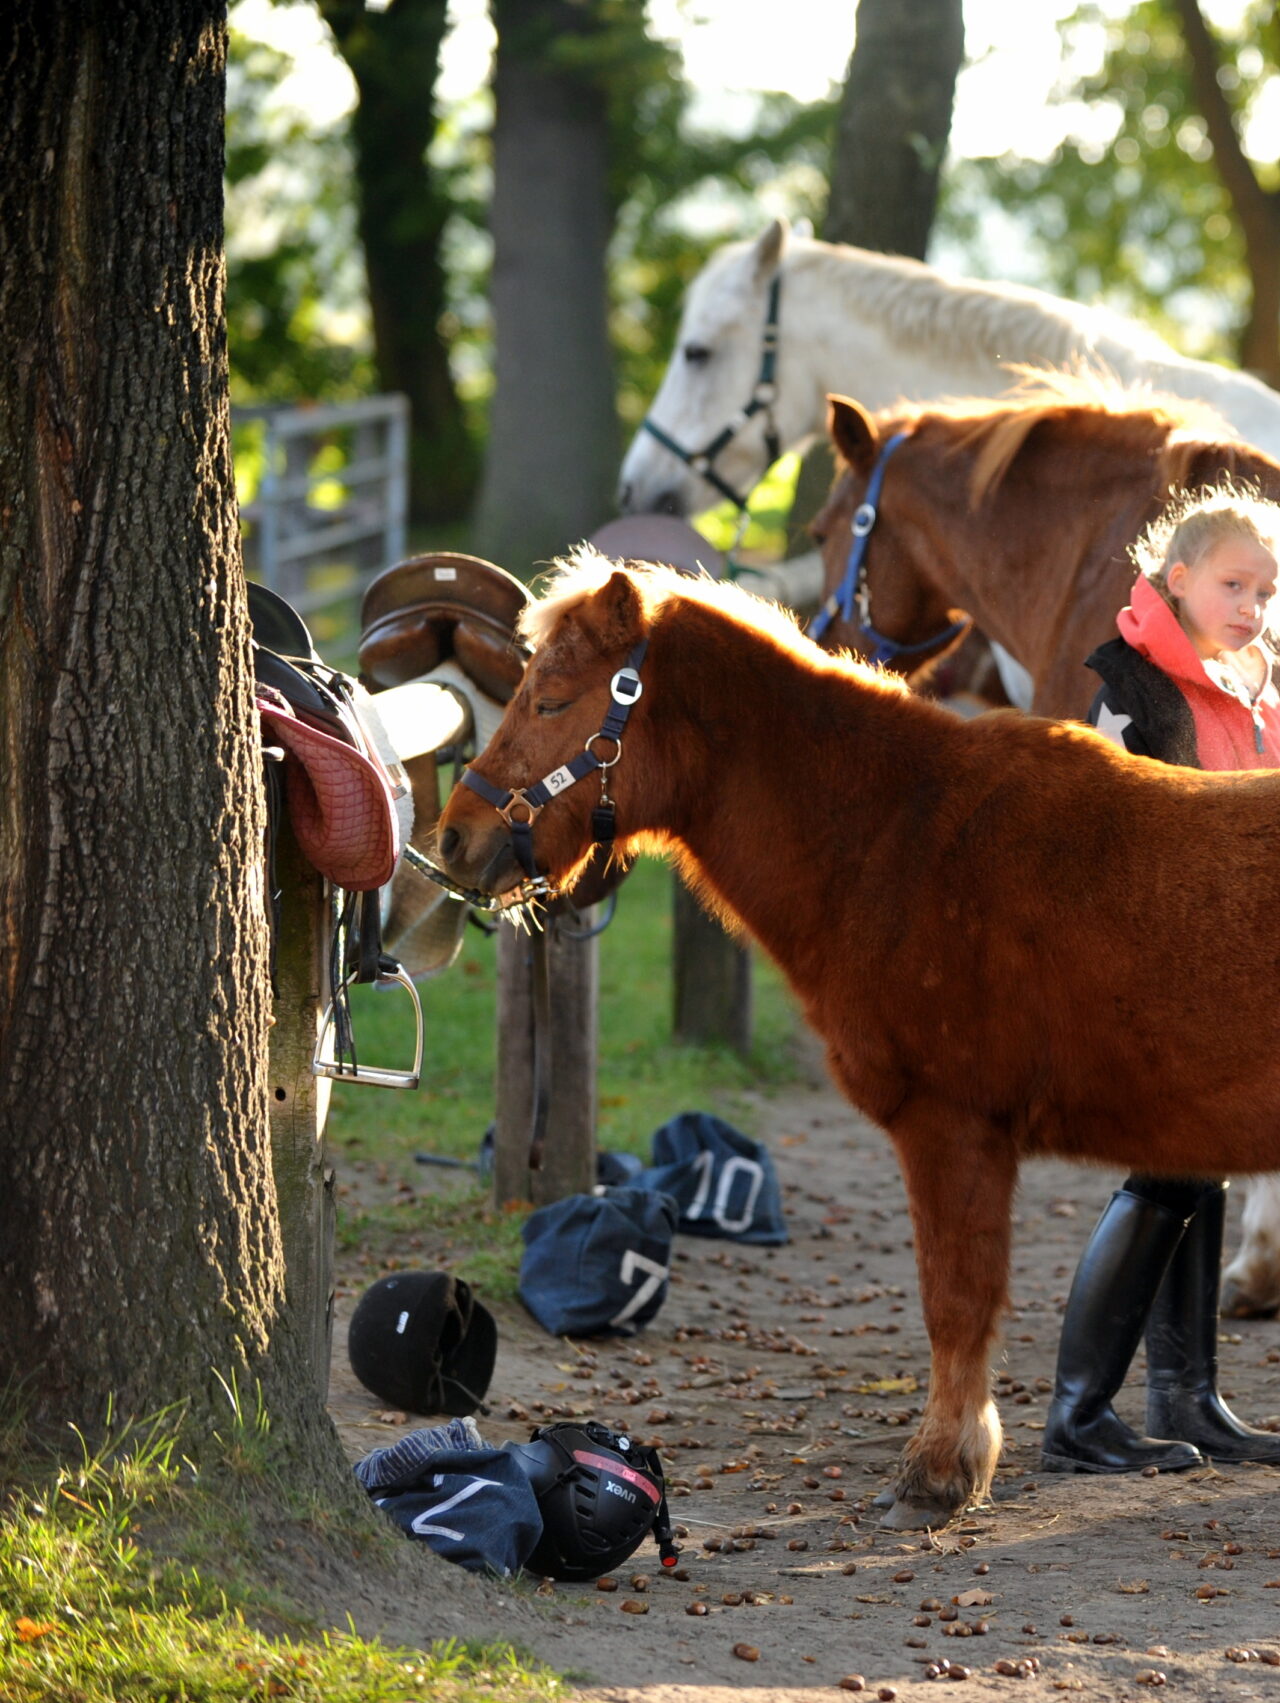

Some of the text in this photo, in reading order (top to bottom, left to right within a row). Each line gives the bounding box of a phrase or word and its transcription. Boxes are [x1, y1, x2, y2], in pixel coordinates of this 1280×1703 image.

[550, 772, 567, 789] 52
[686, 1150, 764, 1232] 10
[609, 1249, 668, 1327] 7
[605, 1480, 637, 1504] uvex
